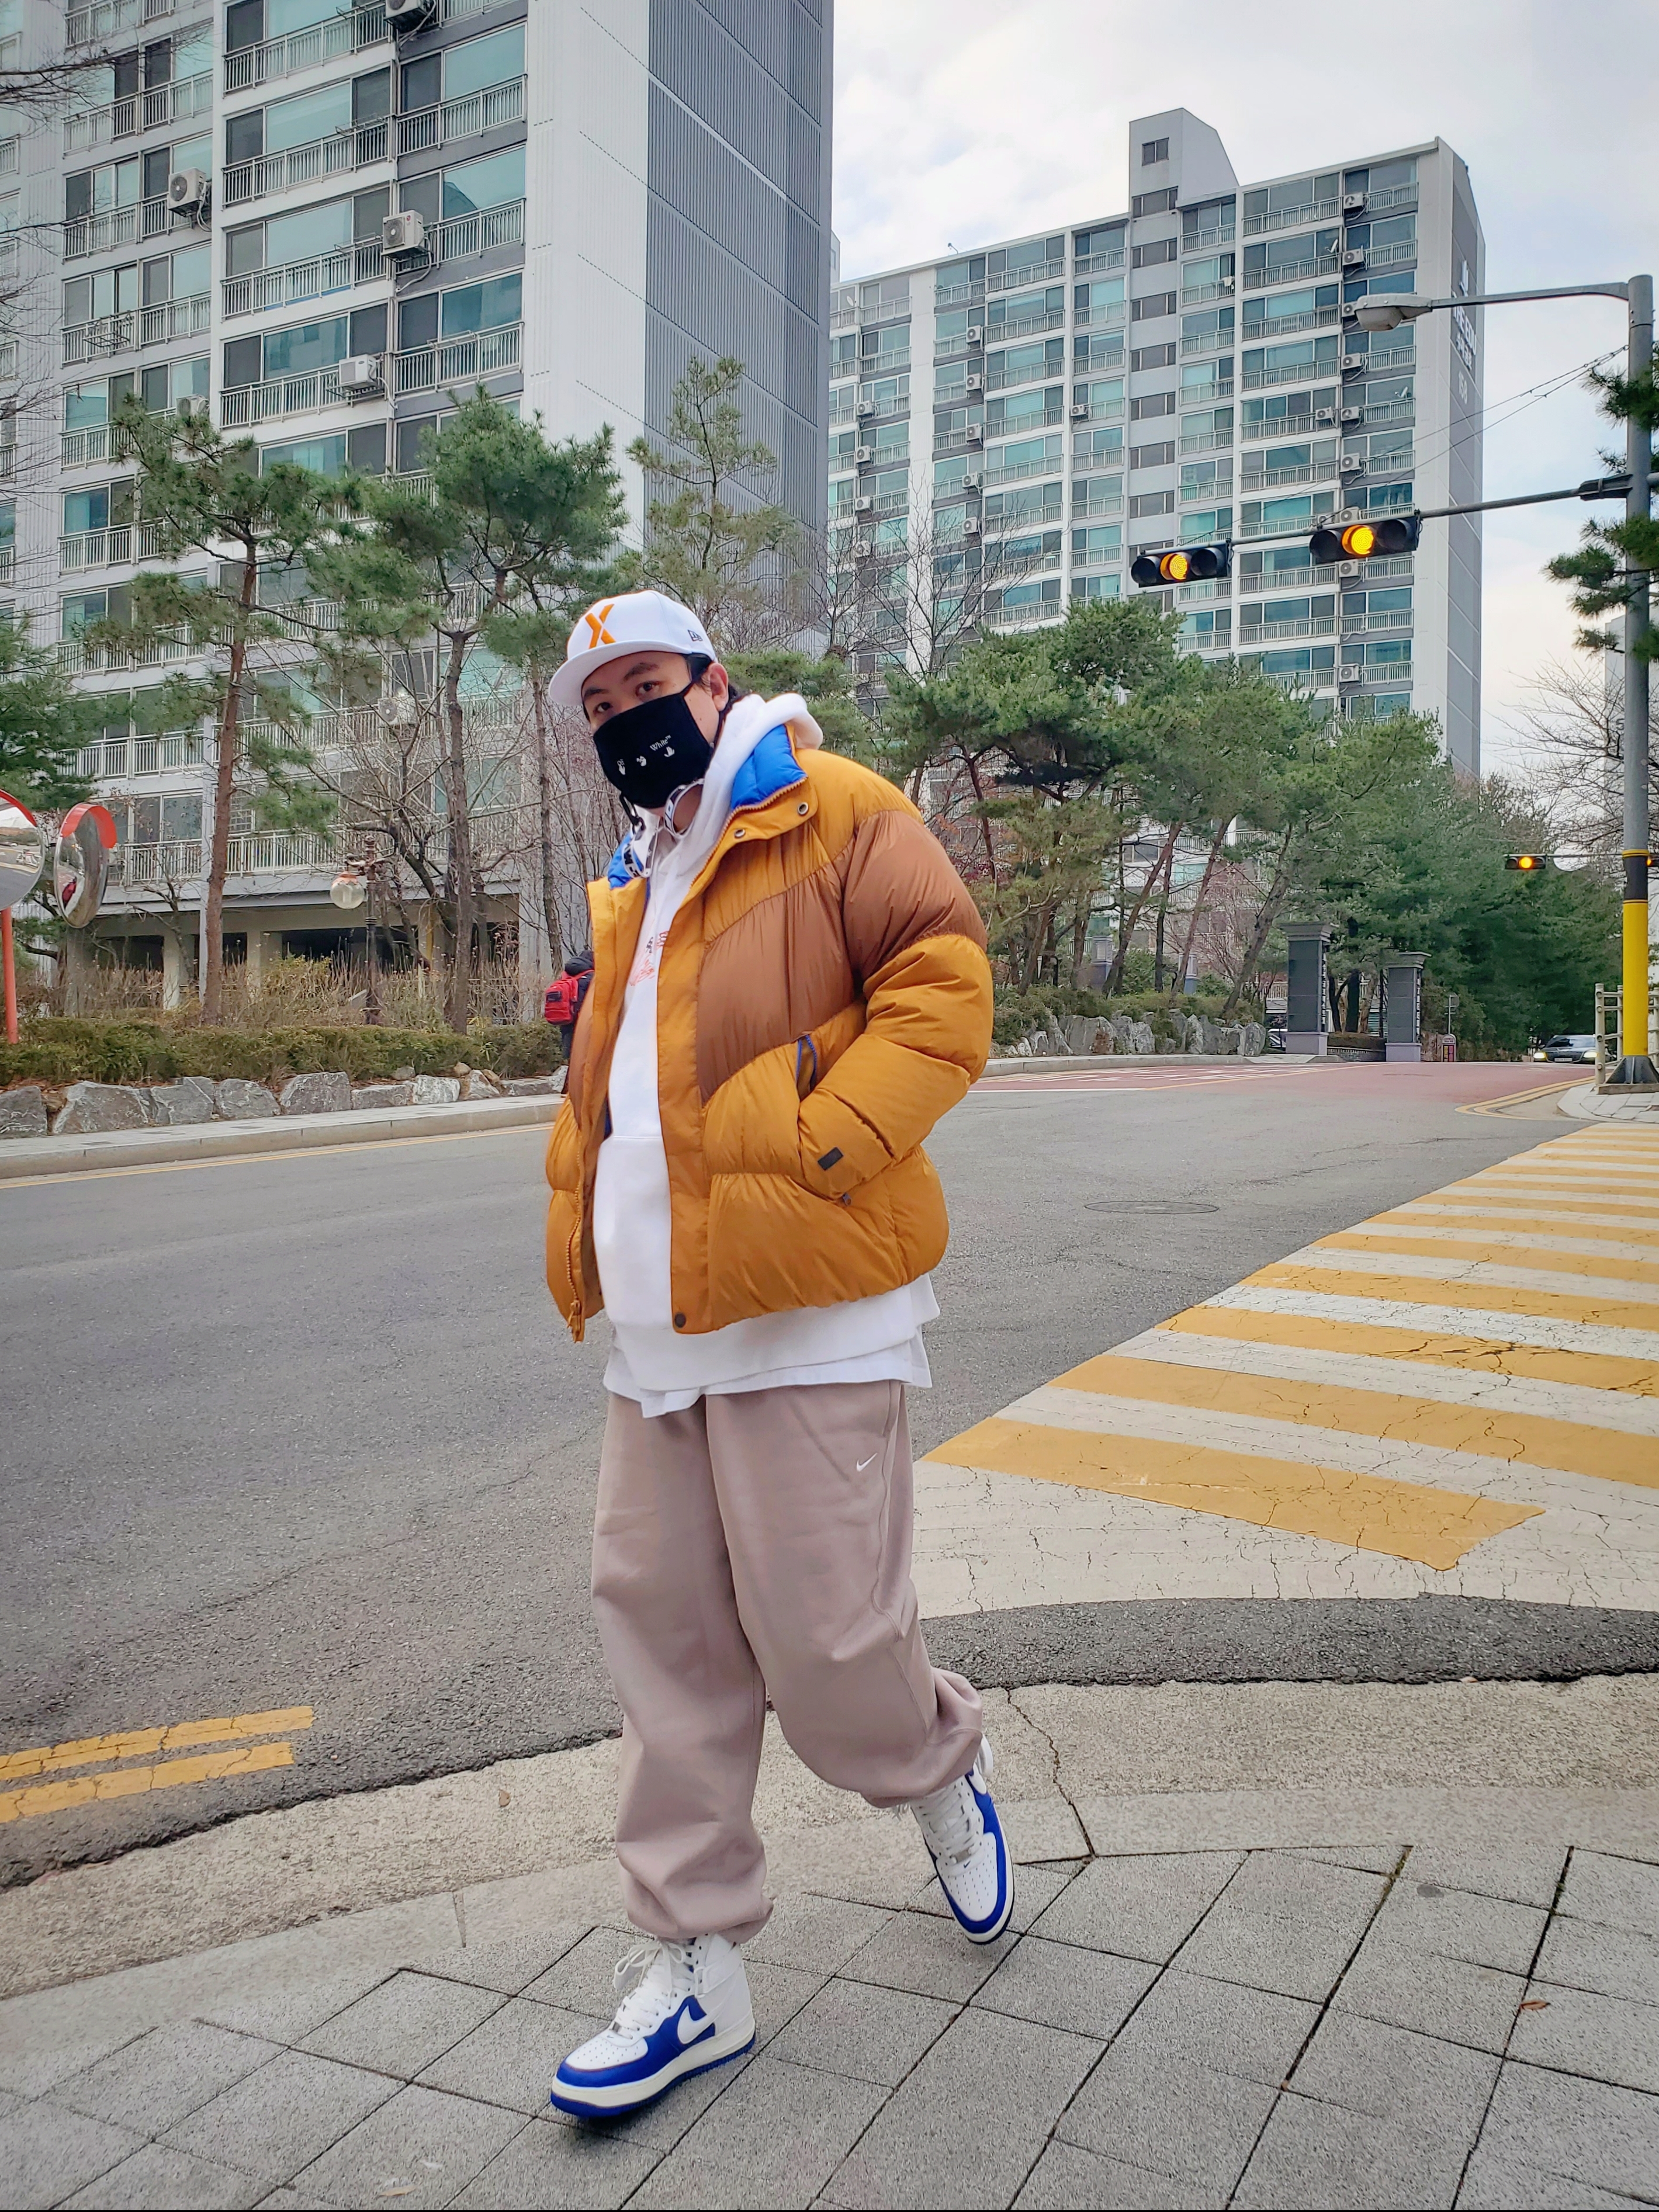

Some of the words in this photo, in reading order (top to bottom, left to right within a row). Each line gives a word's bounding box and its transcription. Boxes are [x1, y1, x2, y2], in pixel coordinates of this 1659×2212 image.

[1465, 315, 1477, 356] EDU
[1459, 370, 1468, 405] 158
[585, 604, 617, 649] X
